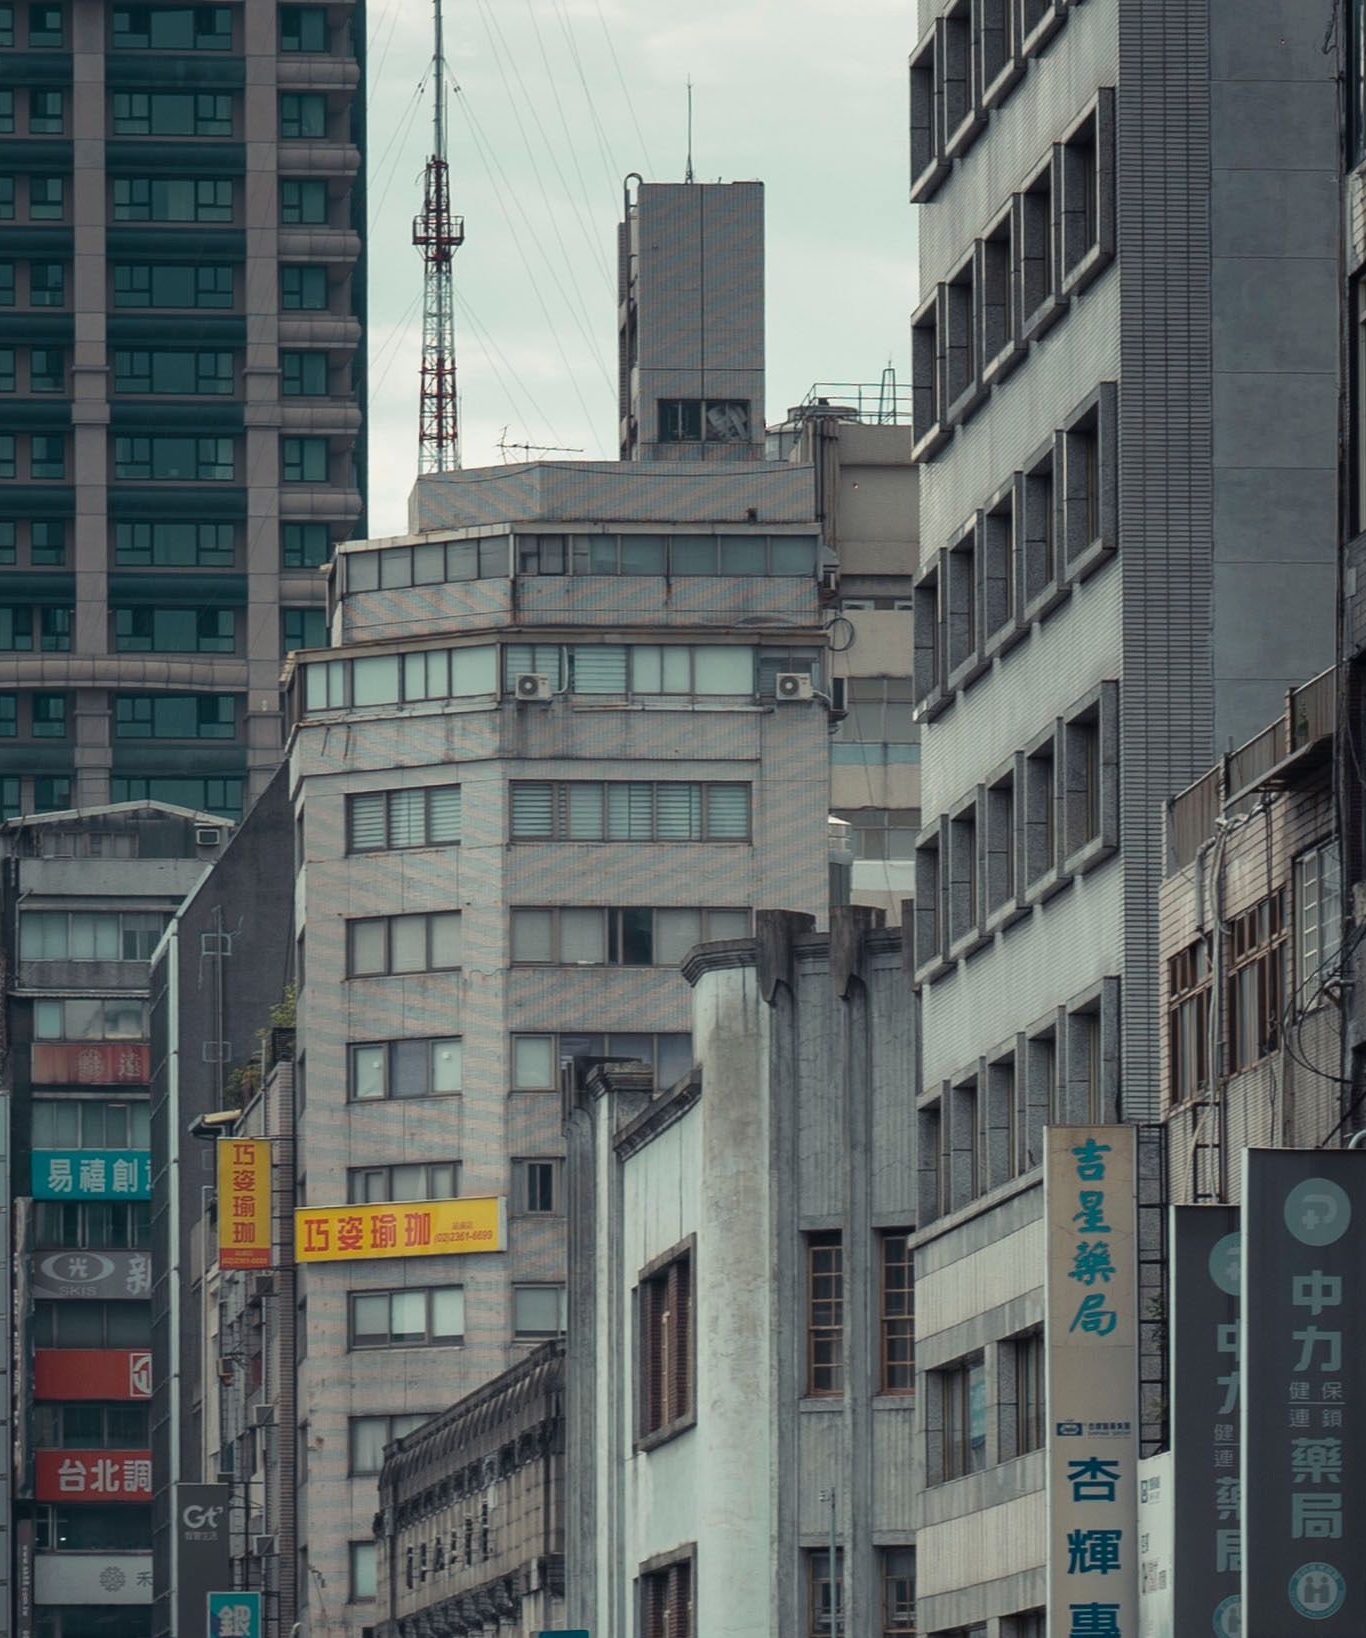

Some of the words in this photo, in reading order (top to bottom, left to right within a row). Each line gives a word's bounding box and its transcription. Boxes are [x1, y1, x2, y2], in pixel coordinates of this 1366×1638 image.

[47, 1158, 151, 1193] 易禧創
[232, 1143, 256, 1243] 巧姿瑜珈
[303, 1212, 432, 1252] 巧姿瑜珈
[1068, 1138, 1118, 1338] 吉星藥局
[58, 1285, 97, 1296] SKIS
[1291, 1269, 1344, 1373] 中力
[1288, 1381, 1344, 1400] 健保
[1288, 1408, 1344, 1429] 連鎖
[58, 1458, 152, 1492] 台北調
[1290, 1436, 1344, 1540] 藥局
